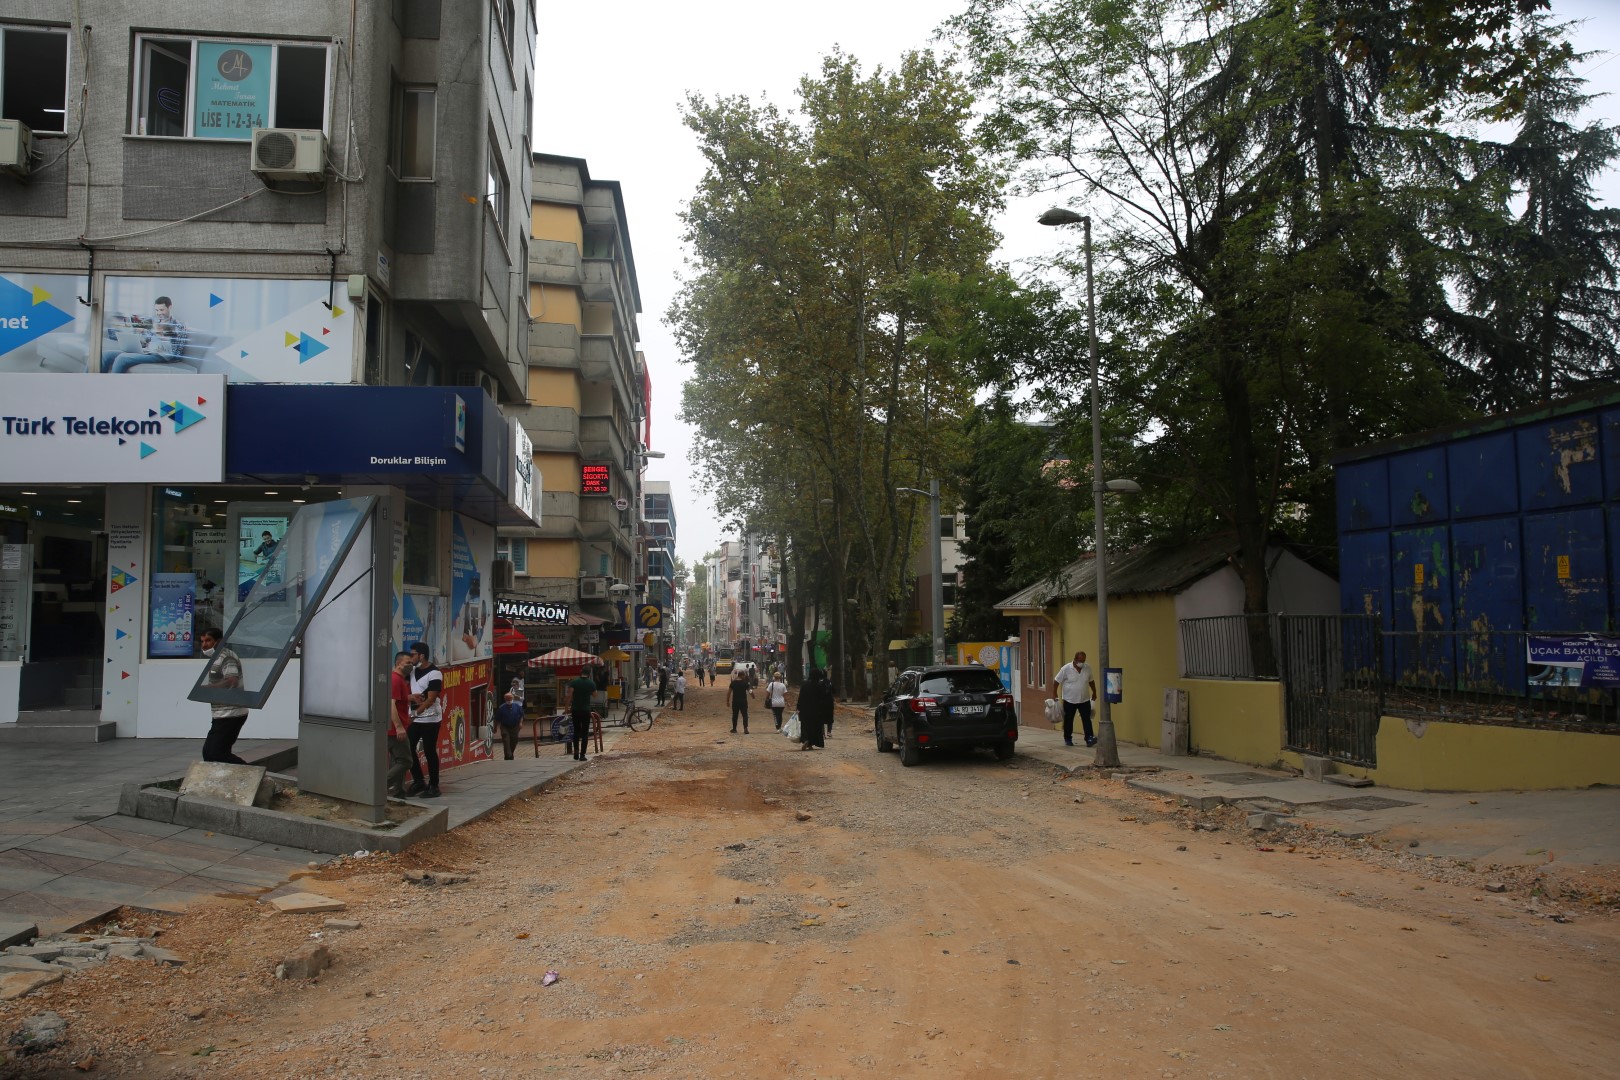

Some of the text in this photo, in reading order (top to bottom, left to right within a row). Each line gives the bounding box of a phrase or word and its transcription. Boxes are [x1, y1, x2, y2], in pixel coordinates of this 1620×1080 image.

[202, 109, 262, 129] LİSE 1-2-3-4
[2, 415, 162, 436] Türk Telekom
[370, 456, 447, 467] Doruklar Bilişim
[498, 602, 566, 620] MAKARON
[1530, 647, 1560, 656] UÇAK
[1564, 647, 1601, 655] BAKIM
